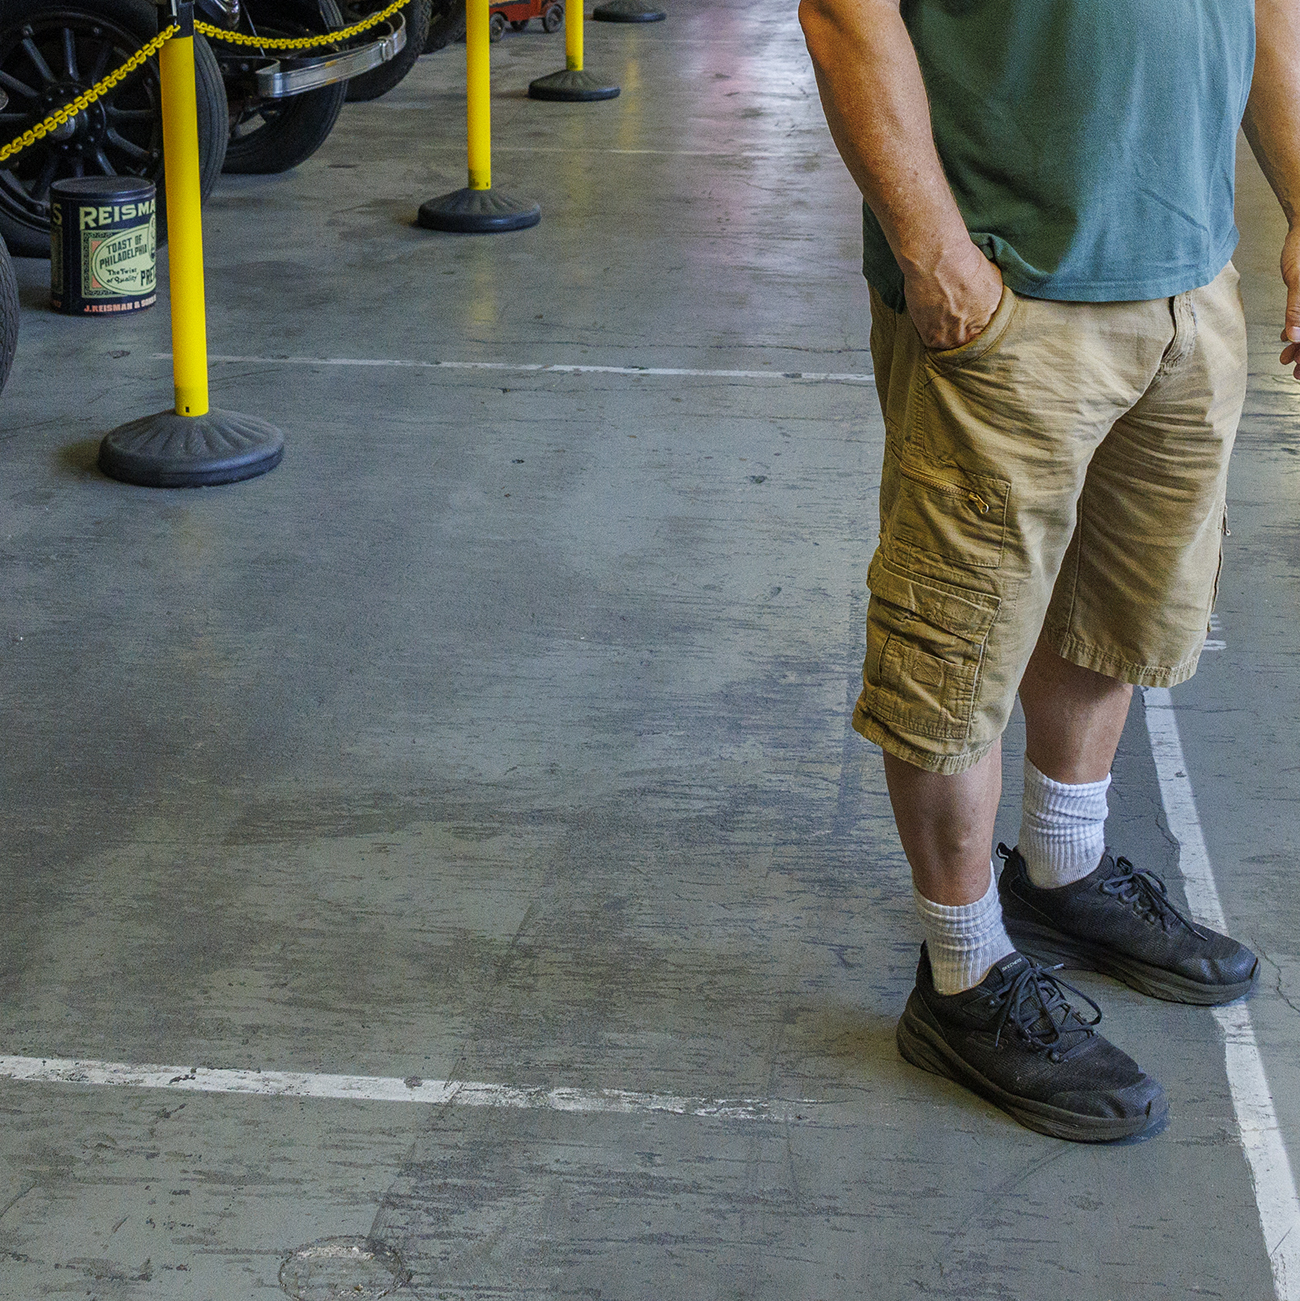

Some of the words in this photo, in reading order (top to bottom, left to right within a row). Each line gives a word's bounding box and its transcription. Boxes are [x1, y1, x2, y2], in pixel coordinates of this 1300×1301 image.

[106, 237, 133, 255] TOAST
[134, 233, 143, 245] OF
[99, 245, 148, 270] PHILADELPHIA
